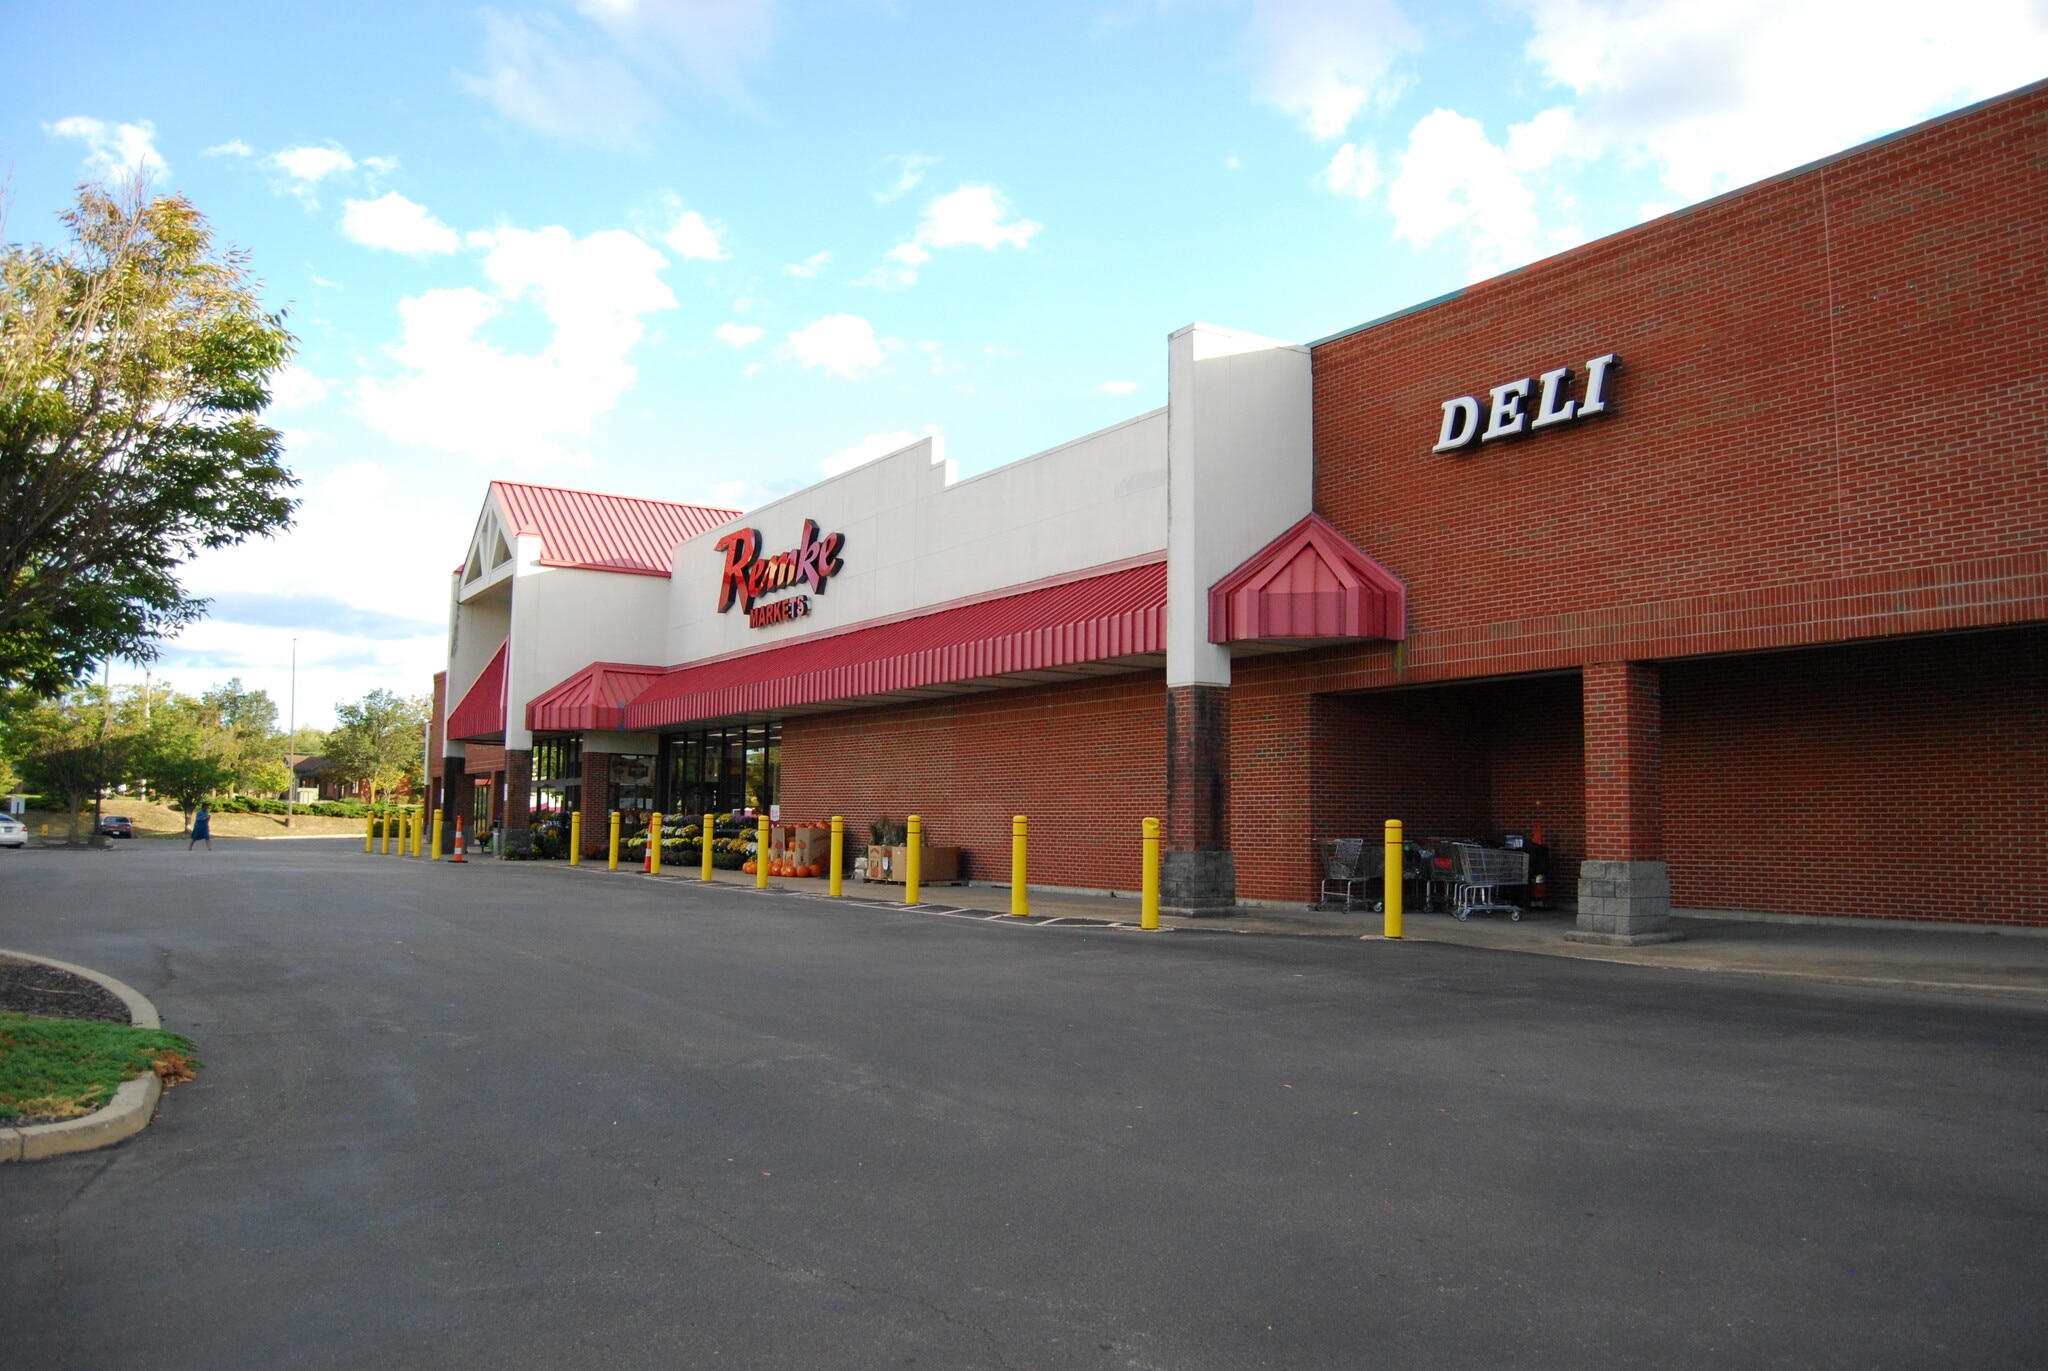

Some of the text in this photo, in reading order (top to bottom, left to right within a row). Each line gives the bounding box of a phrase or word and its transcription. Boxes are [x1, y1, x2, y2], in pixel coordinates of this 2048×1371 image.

[1432, 353, 1622, 453] DELI
[714, 518, 845, 615] Remke
[750, 595, 807, 628] MARKETS
